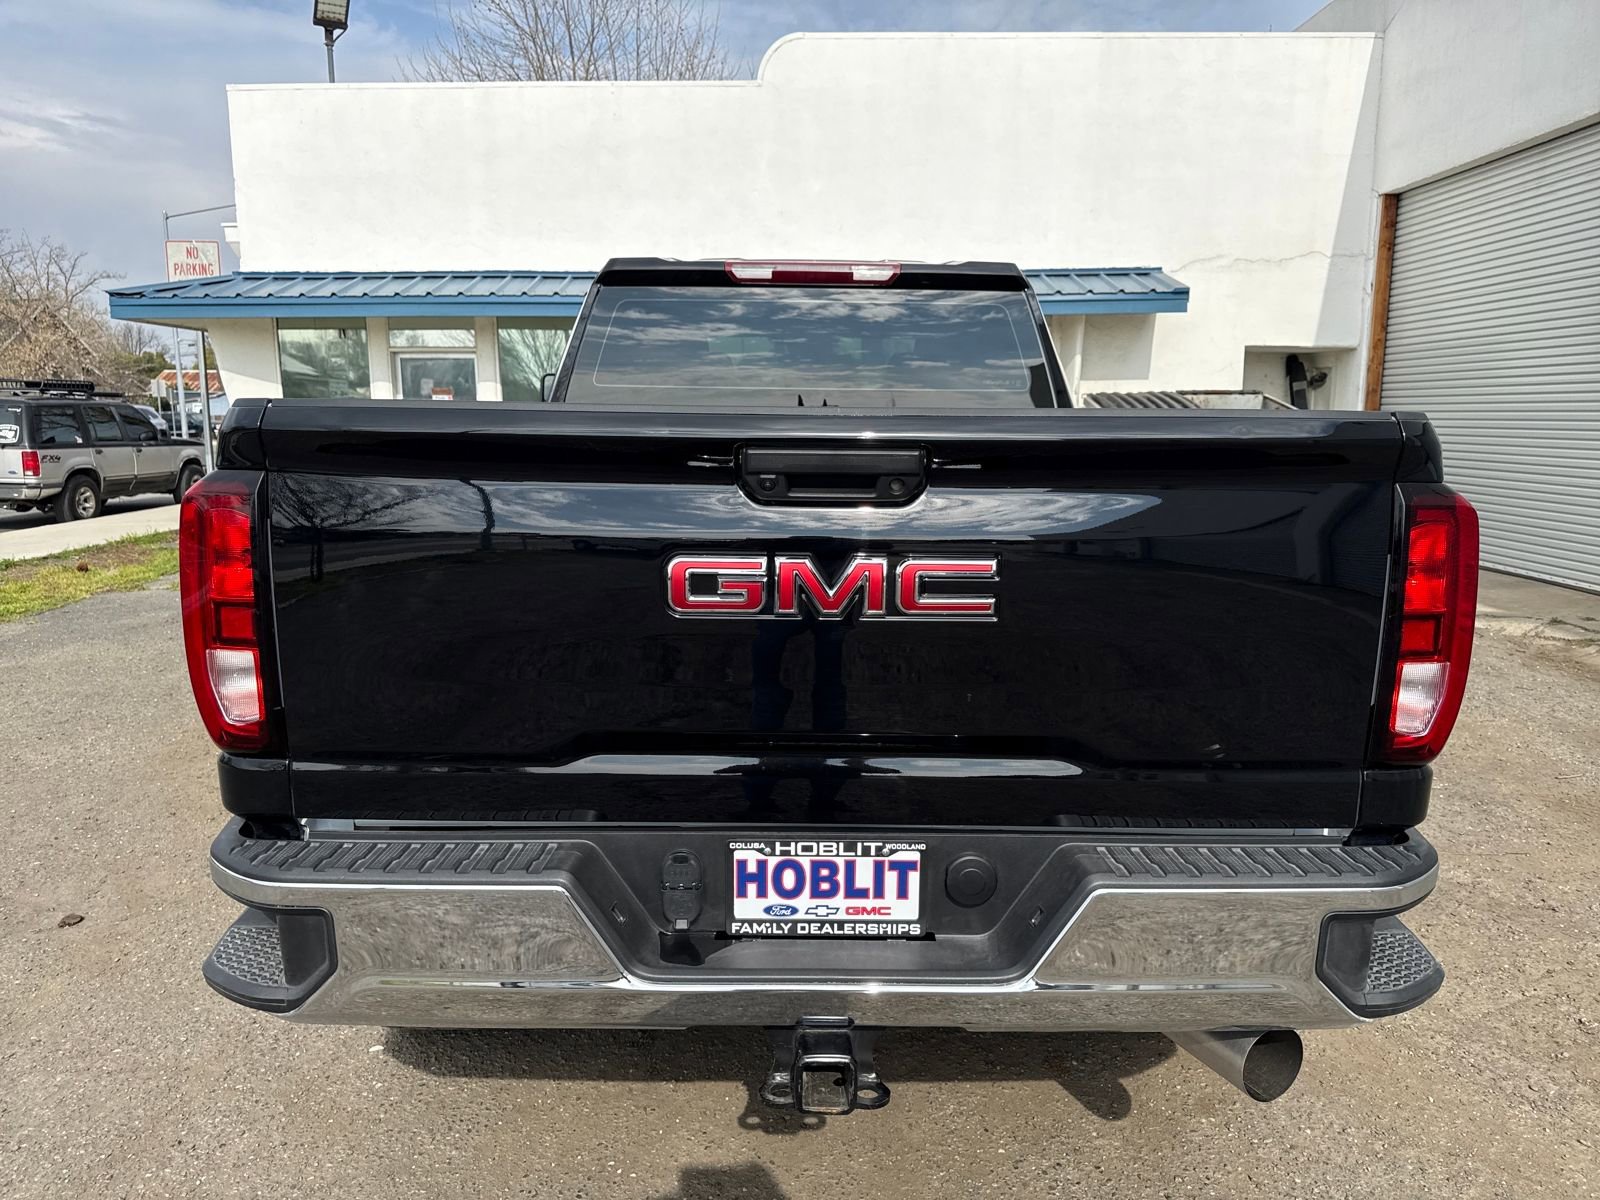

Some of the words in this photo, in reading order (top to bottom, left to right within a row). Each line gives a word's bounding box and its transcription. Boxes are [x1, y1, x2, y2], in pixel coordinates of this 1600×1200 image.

[186, 246, 199, 260] NO
[174, 263, 214, 276] PARKING
[667, 554, 999, 620] GMC
[775, 842, 883, 856] HOBLIT
[735, 858, 919, 900] HOBLIT
[768, 905, 793, 916] Ford
[845, 906, 891, 916] GMC
[731, 922, 792, 934] FAMILY
[797, 923, 921, 935] DEALERSHIPS
